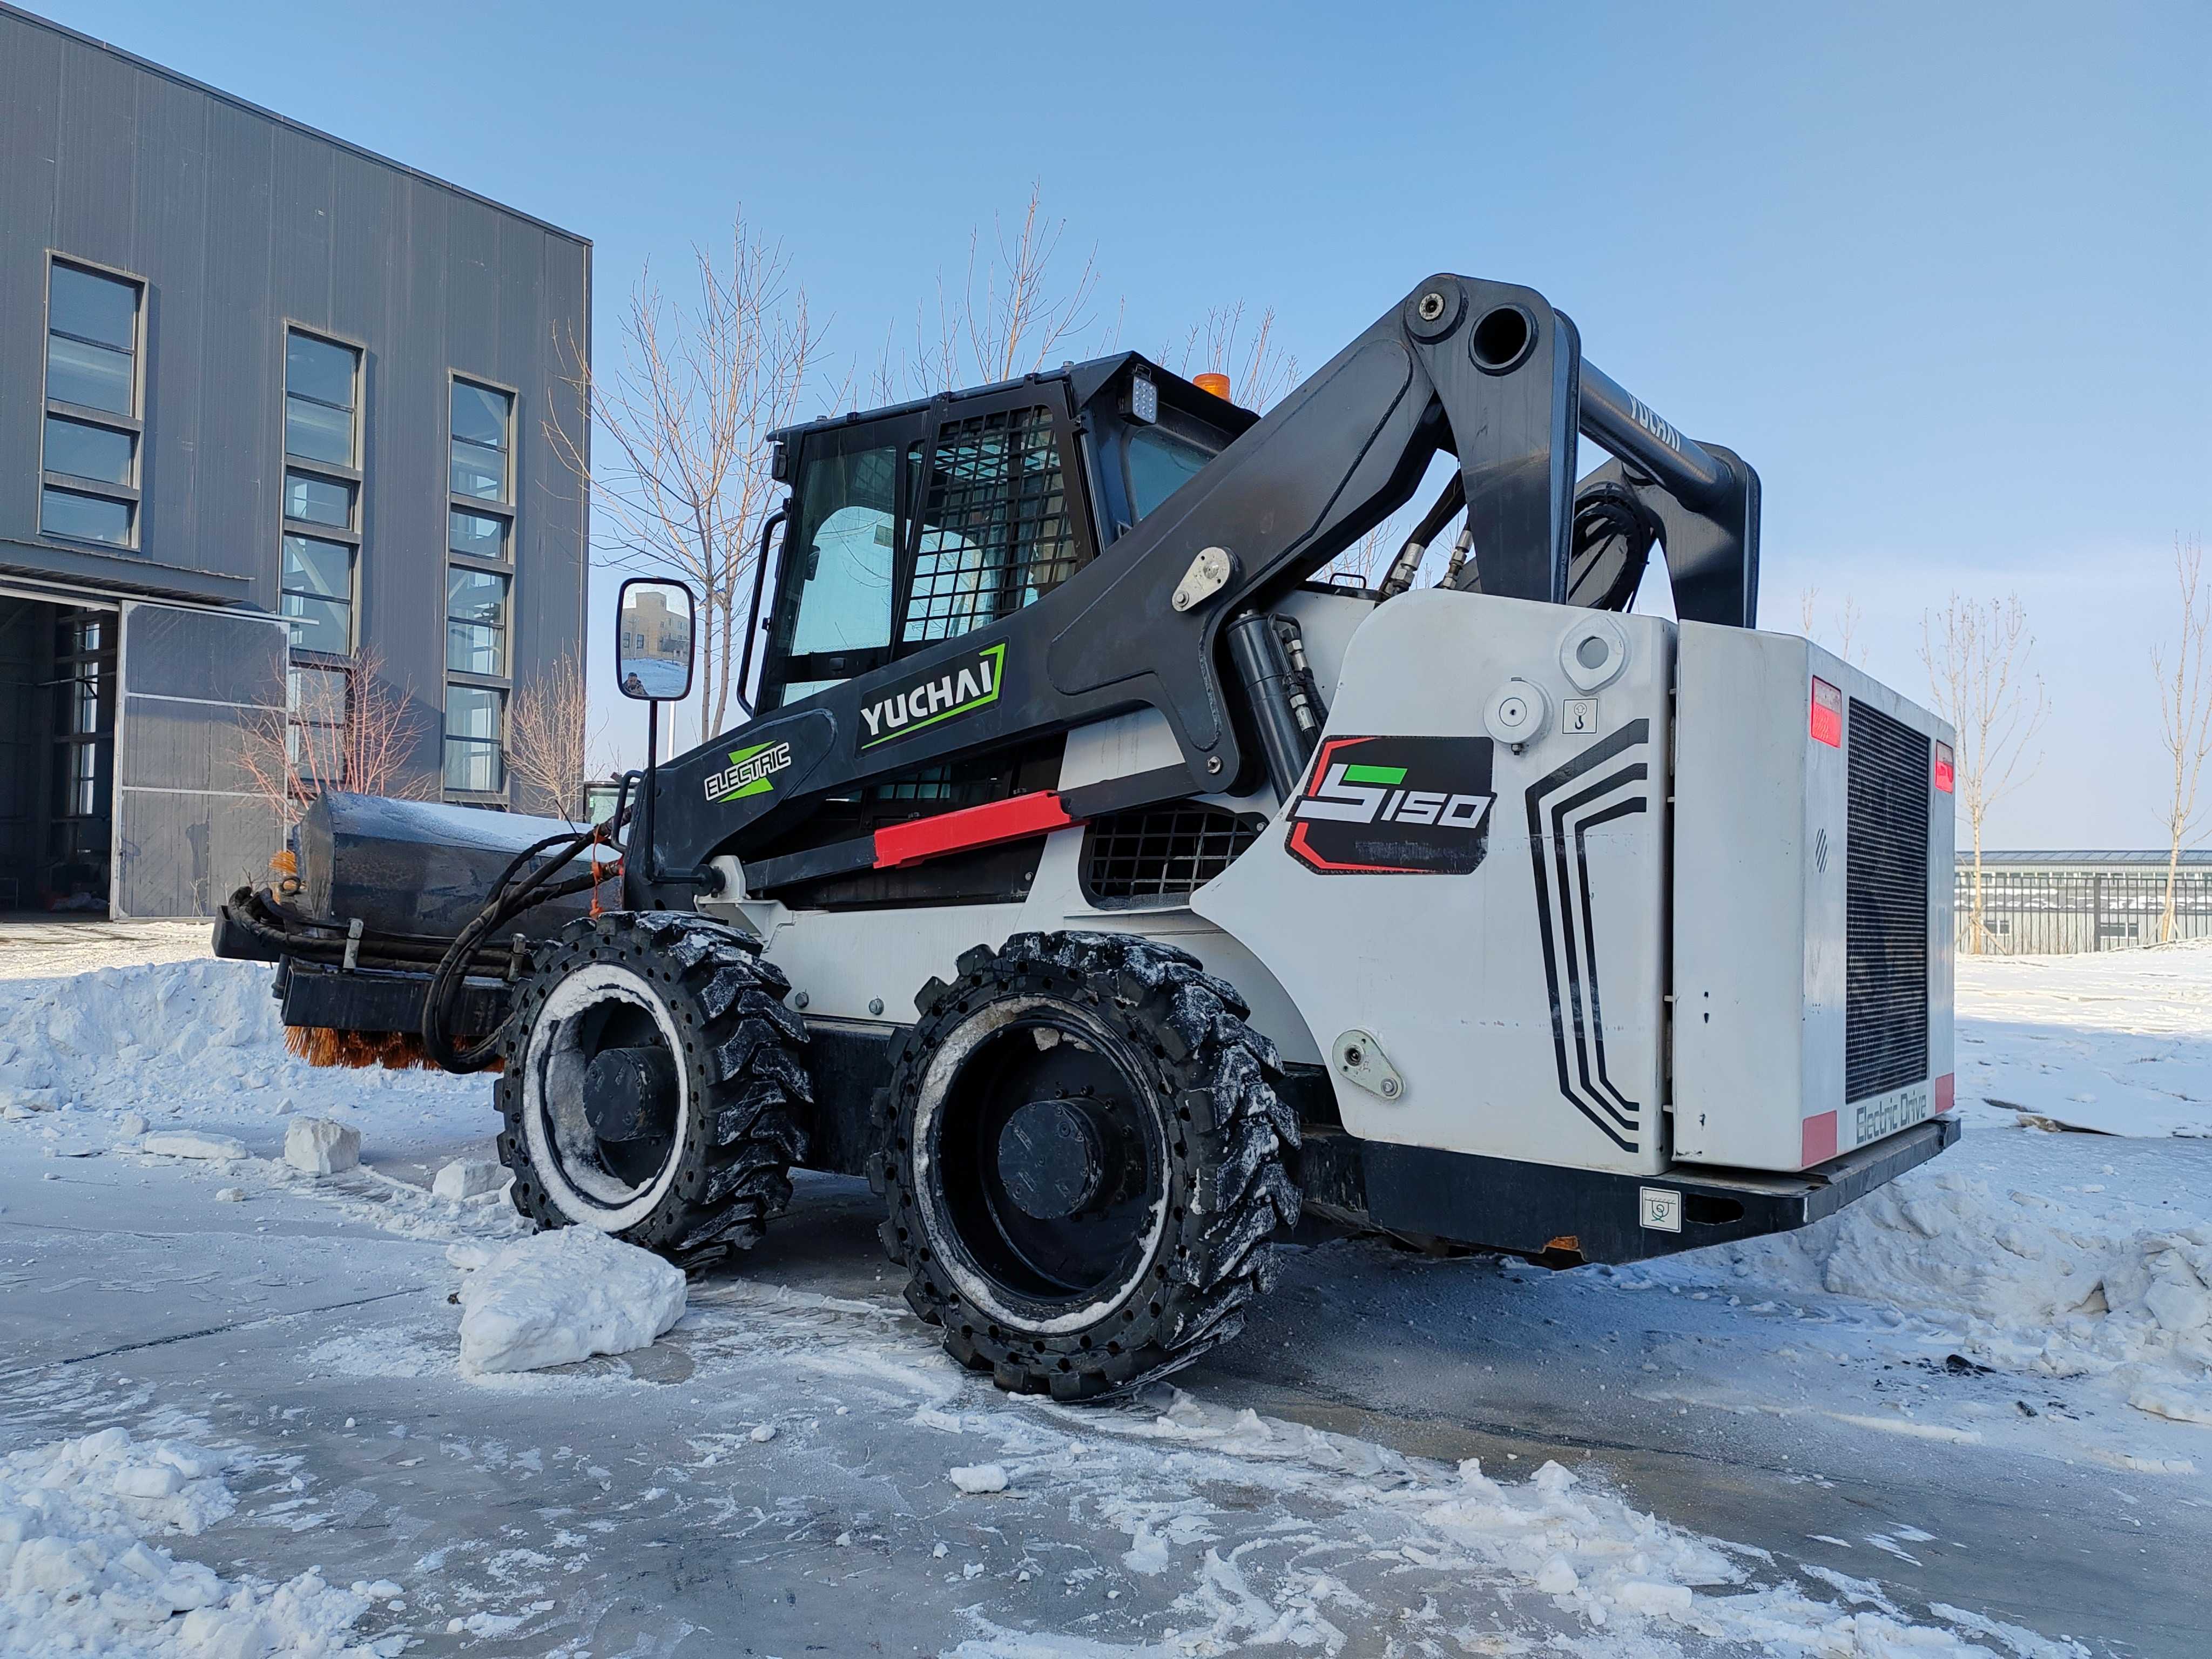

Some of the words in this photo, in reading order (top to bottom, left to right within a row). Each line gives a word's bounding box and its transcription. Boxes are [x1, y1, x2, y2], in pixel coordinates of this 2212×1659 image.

[1627, 393, 1680, 452] YUCHAI
[860, 660, 993, 736] YUCHAI
[704, 742, 791, 801] ELECTRIC
[1857, 1097, 1898, 1144] Electric
[1900, 1089, 1926, 1127] Drive
